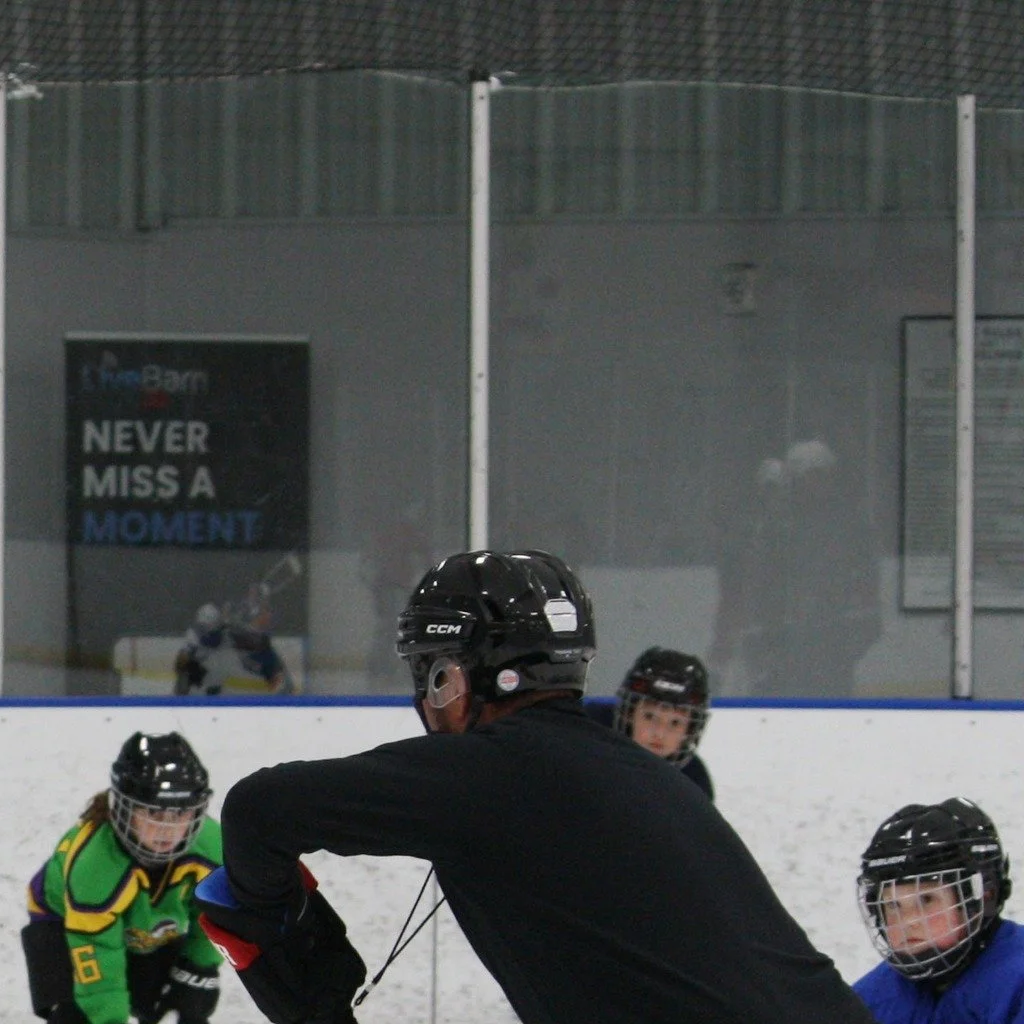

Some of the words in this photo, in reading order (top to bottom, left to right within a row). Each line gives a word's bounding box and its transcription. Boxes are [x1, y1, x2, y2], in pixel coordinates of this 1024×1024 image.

[83, 420, 209, 452] NEVER
[83, 465, 180, 498] MISS
[188, 466, 215, 498] A
[83, 510, 261, 542] MOMENT
[426, 624, 462, 634] CCM
[71, 944, 102, 984] 6
